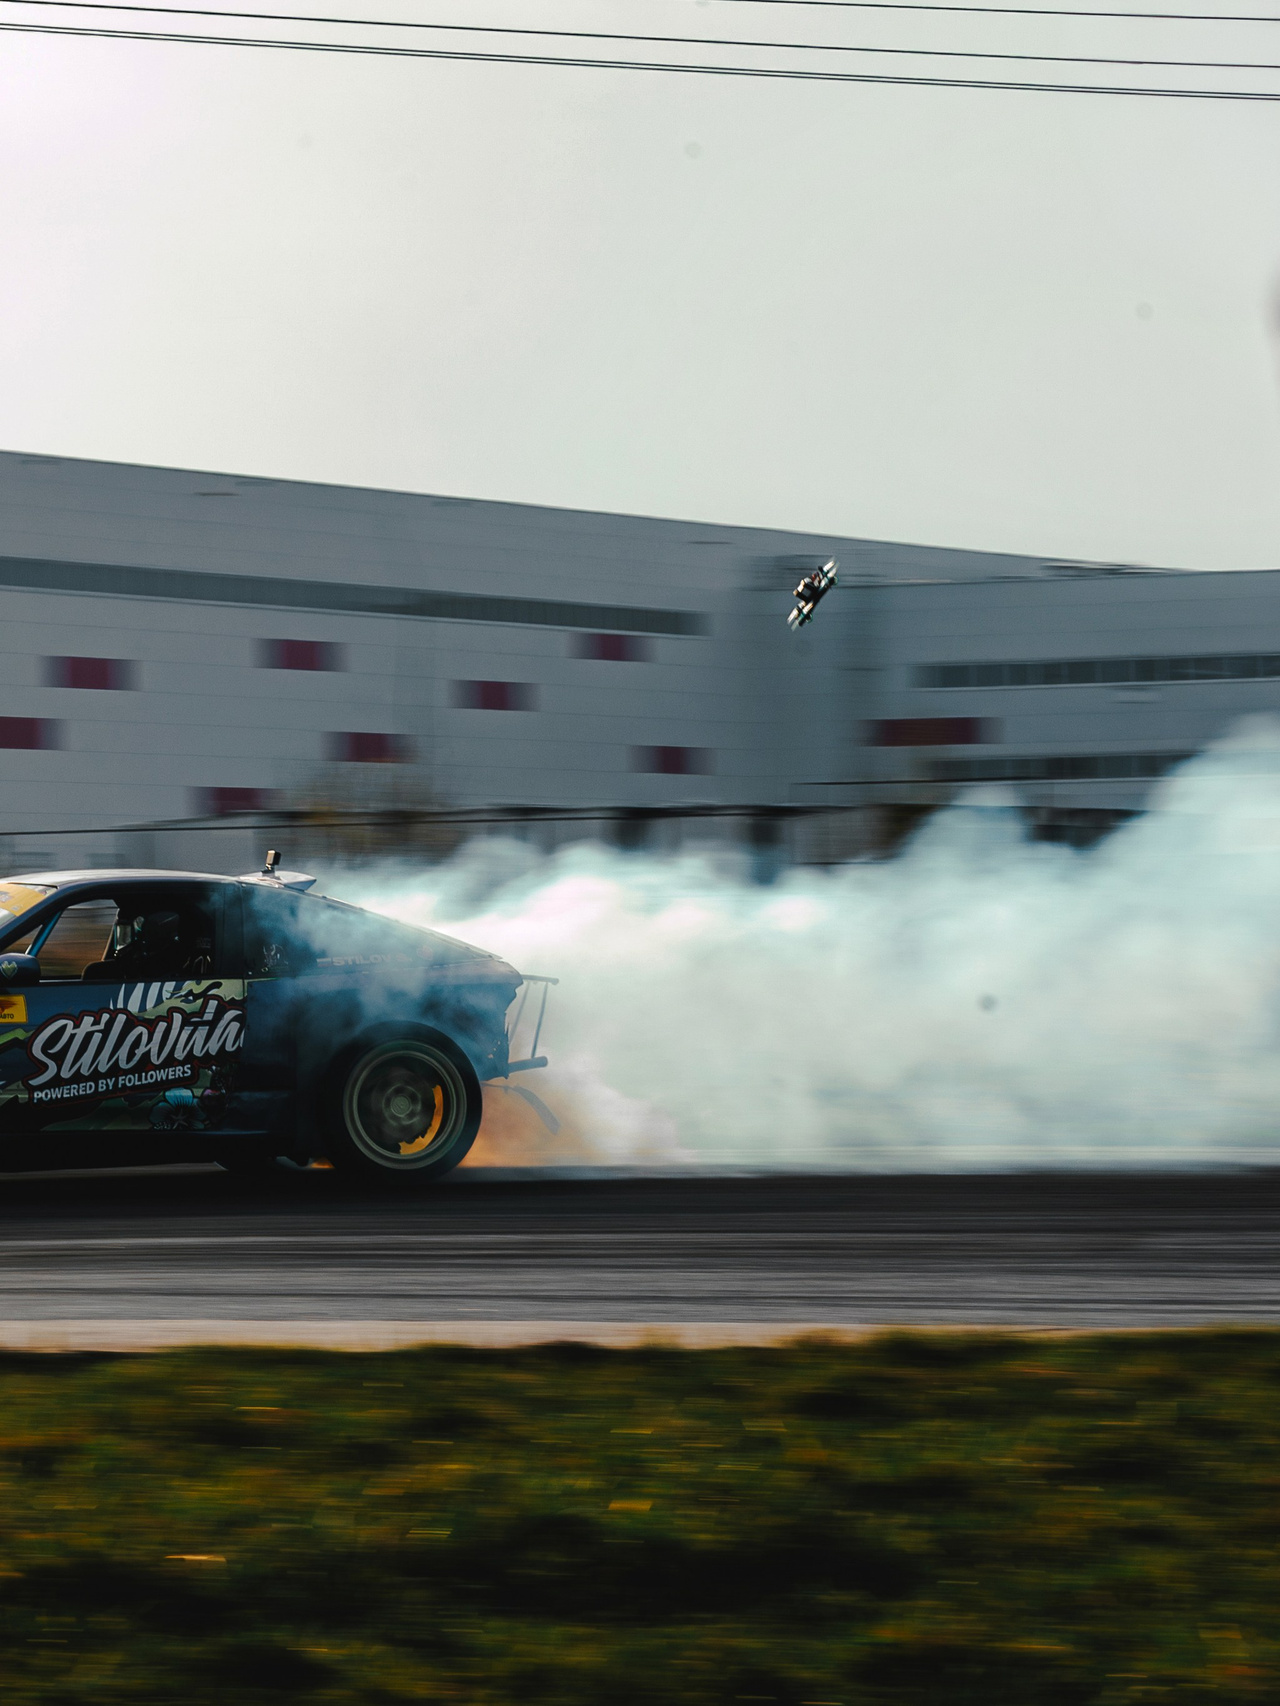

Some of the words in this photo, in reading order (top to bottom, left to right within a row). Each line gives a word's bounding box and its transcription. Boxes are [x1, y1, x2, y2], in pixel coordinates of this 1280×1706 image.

[33, 1080, 95, 1103] POWERED
[98, 1077, 116, 1091] BY
[118, 1064, 191, 1089] FOLLOWERS
